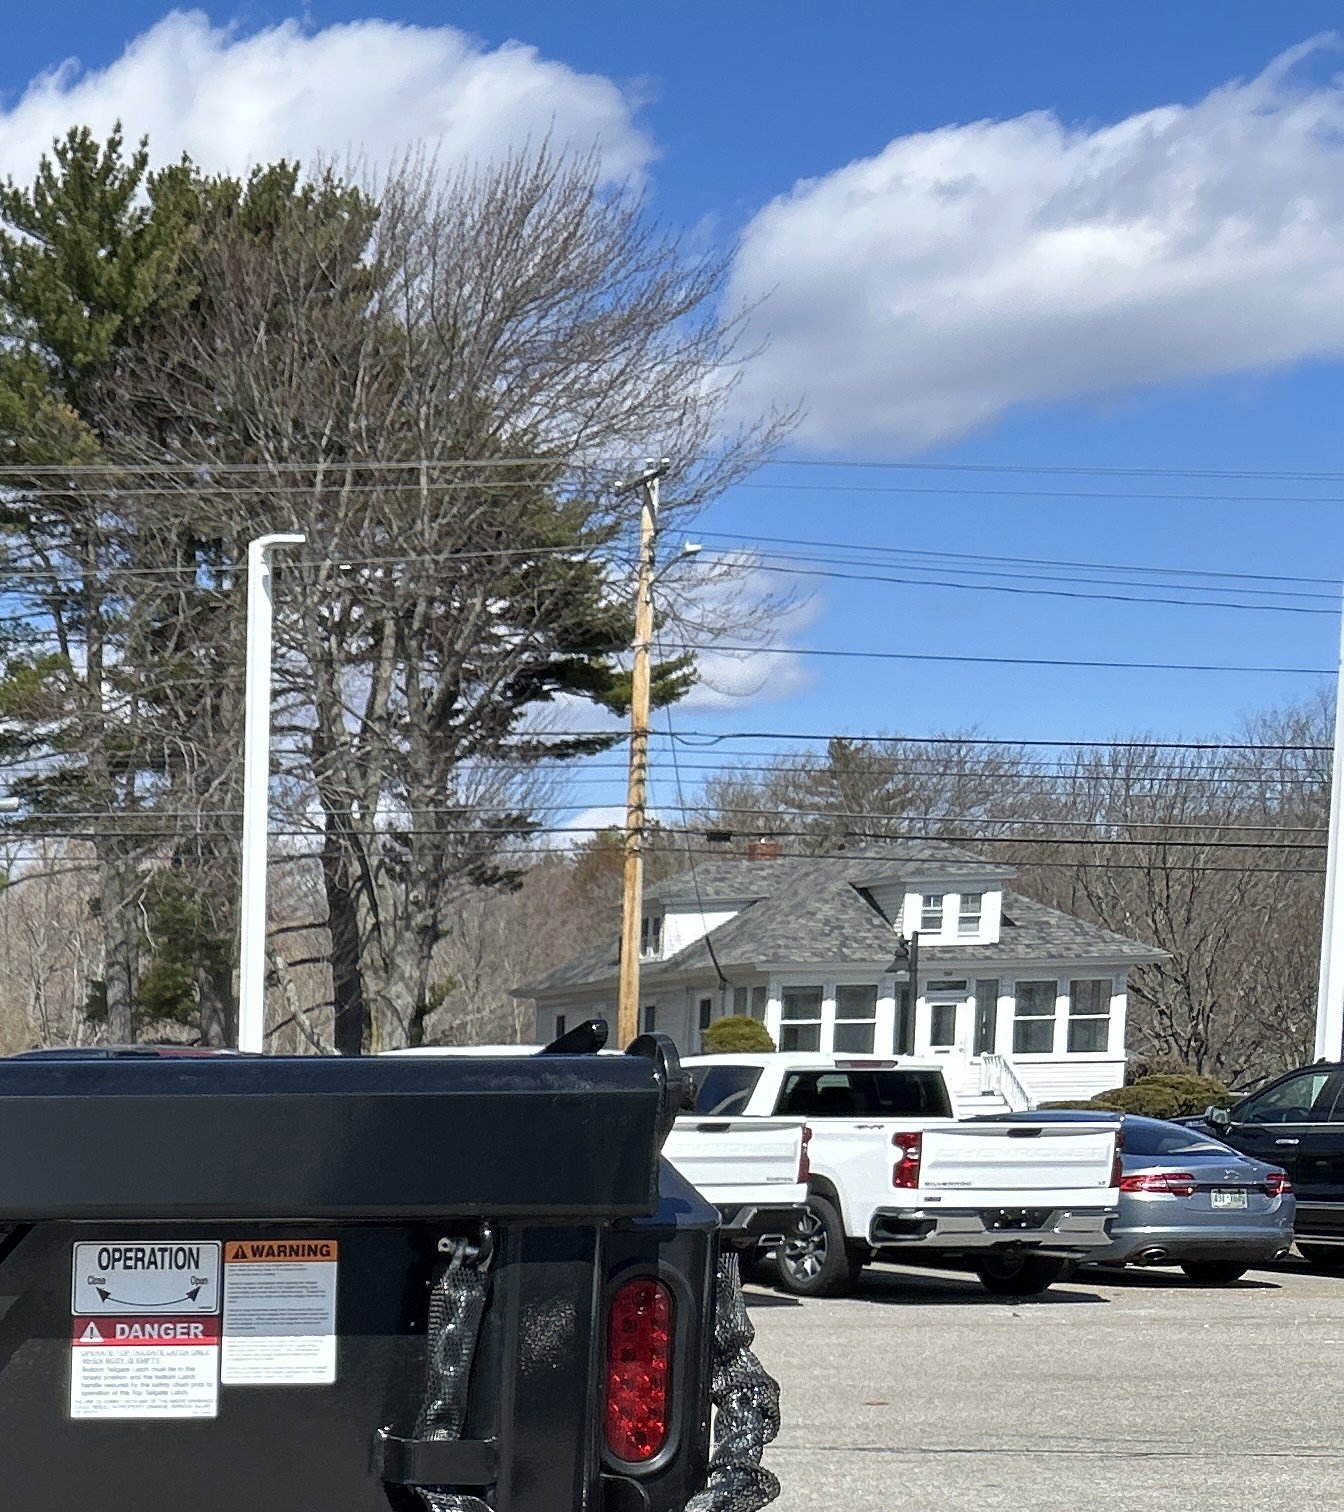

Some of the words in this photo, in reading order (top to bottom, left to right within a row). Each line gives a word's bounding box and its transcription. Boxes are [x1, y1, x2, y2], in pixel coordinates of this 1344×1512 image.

[97, 1246, 201, 1271] OPERATION
[250, 1244, 332, 1258] WARNING
[115, 1323, 205, 1340] DANGER
